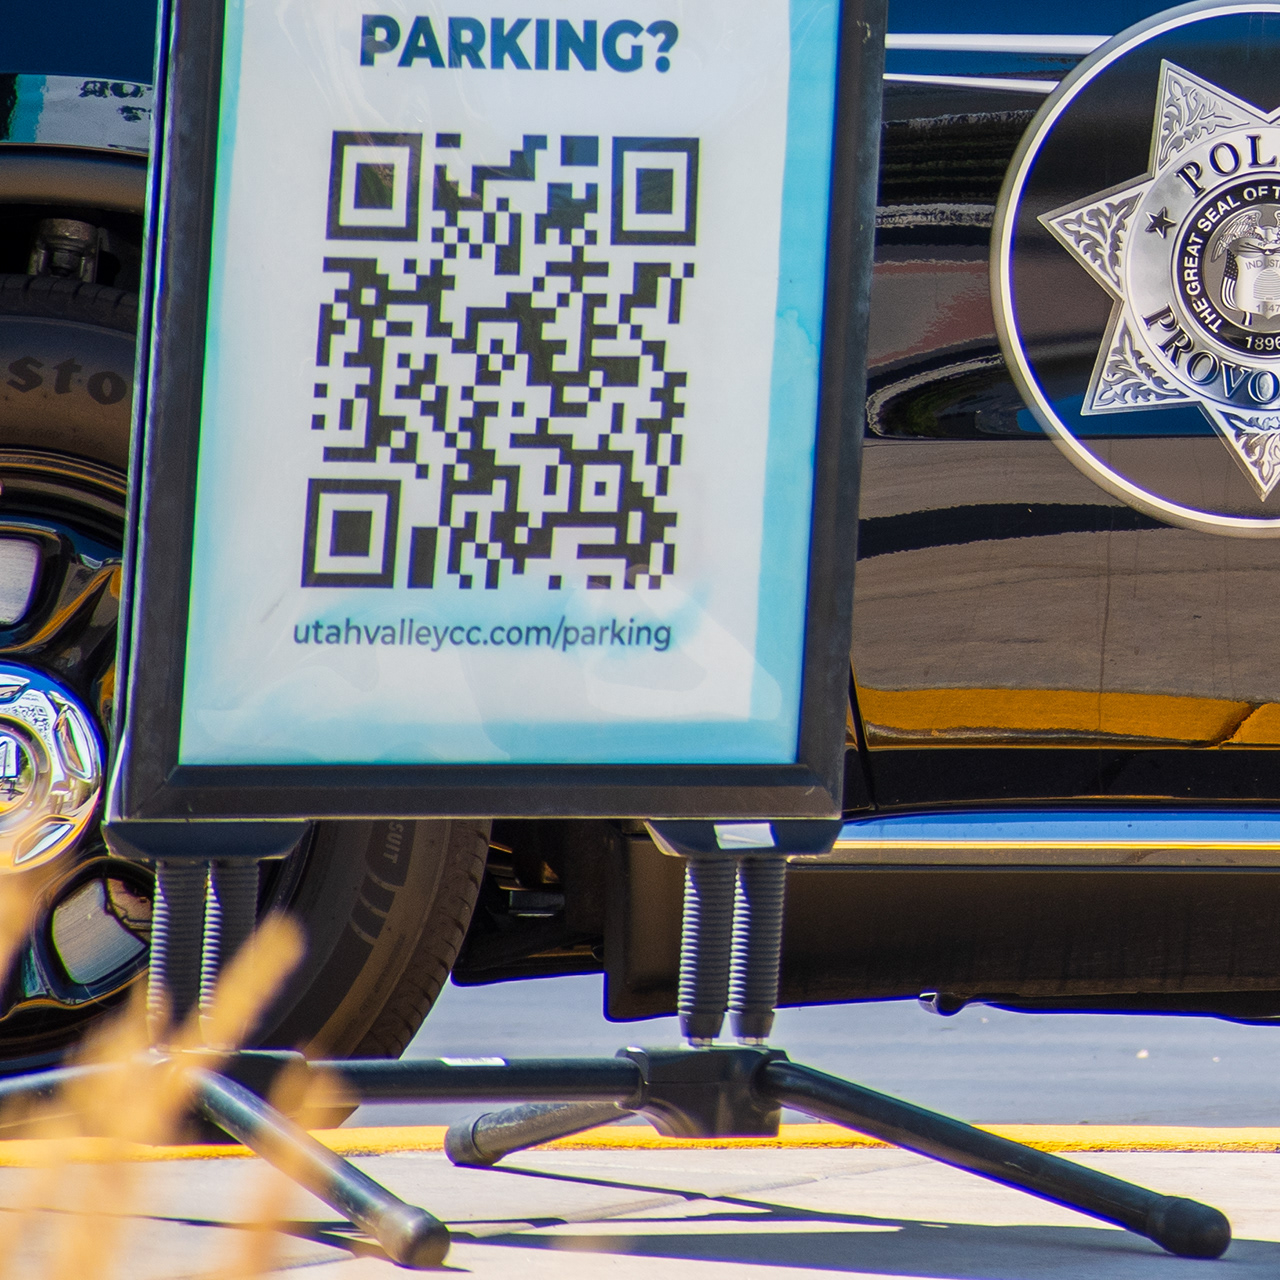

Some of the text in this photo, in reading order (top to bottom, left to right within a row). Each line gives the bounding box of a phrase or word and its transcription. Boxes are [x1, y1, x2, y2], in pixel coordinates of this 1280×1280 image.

[358, 14, 680, 73] PARKING?
[1243, 186, 1268, 201] OF
[1197, 195, 1241, 232] SEAL
[1184, 232, 1204, 295] GREAT
[1192, 298, 1222, 333] THE
[1141, 302, 1280, 404] PROVO
[293, 615, 672, 652] utahvalleycc.com/parking
